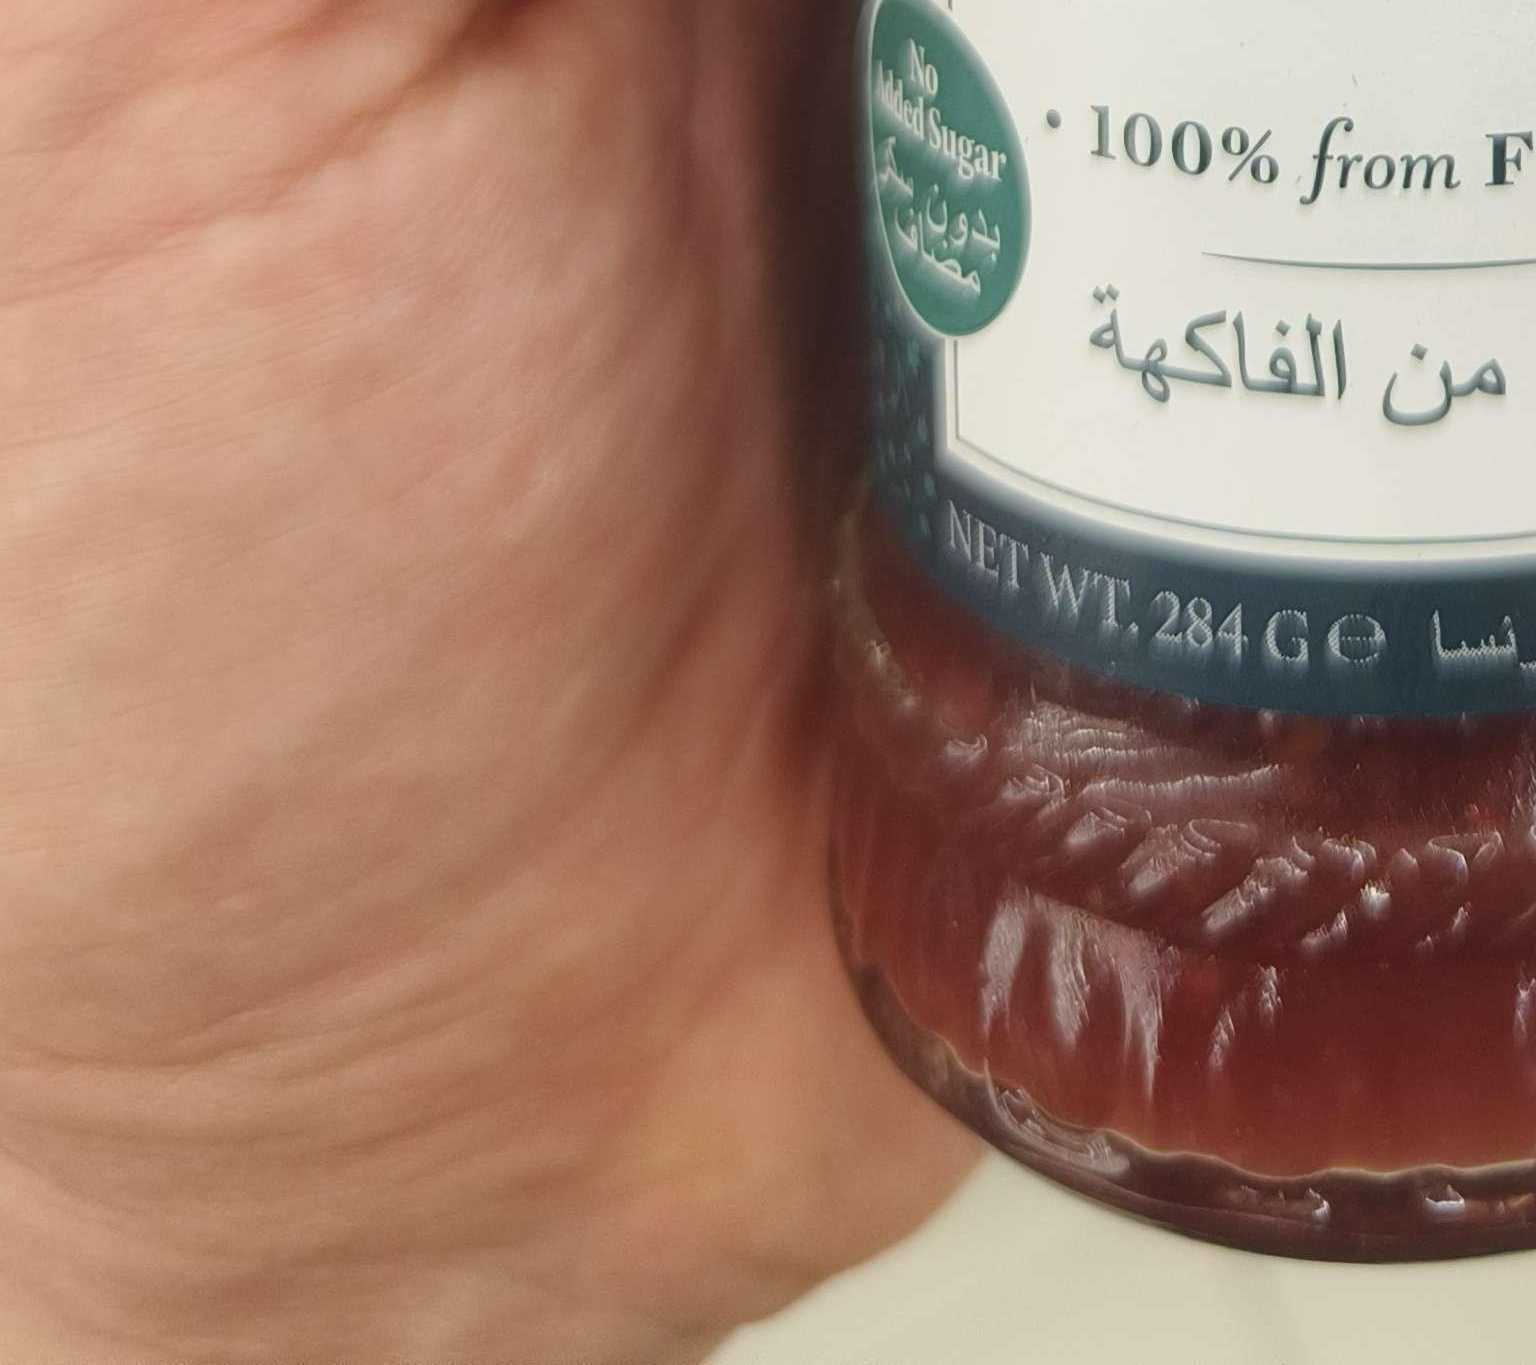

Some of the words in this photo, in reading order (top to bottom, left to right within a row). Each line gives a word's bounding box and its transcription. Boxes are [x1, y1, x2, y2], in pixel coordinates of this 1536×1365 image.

[908, 37, 939, 97] No
[929, 105, 1007, 182] Sugar
[1089, 104, 1280, 185] 100%
[1299, 116, 1461, 206] from
[926, 183, 1001, 263] بدون
[1089, 282, 1346, 404] الفاكهة
[1381, 342, 1507, 427] من
[948, 500, 1029, 590] NET
[1039, 551, 1139, 633] WT.
[1151, 590, 1248, 660] 284
